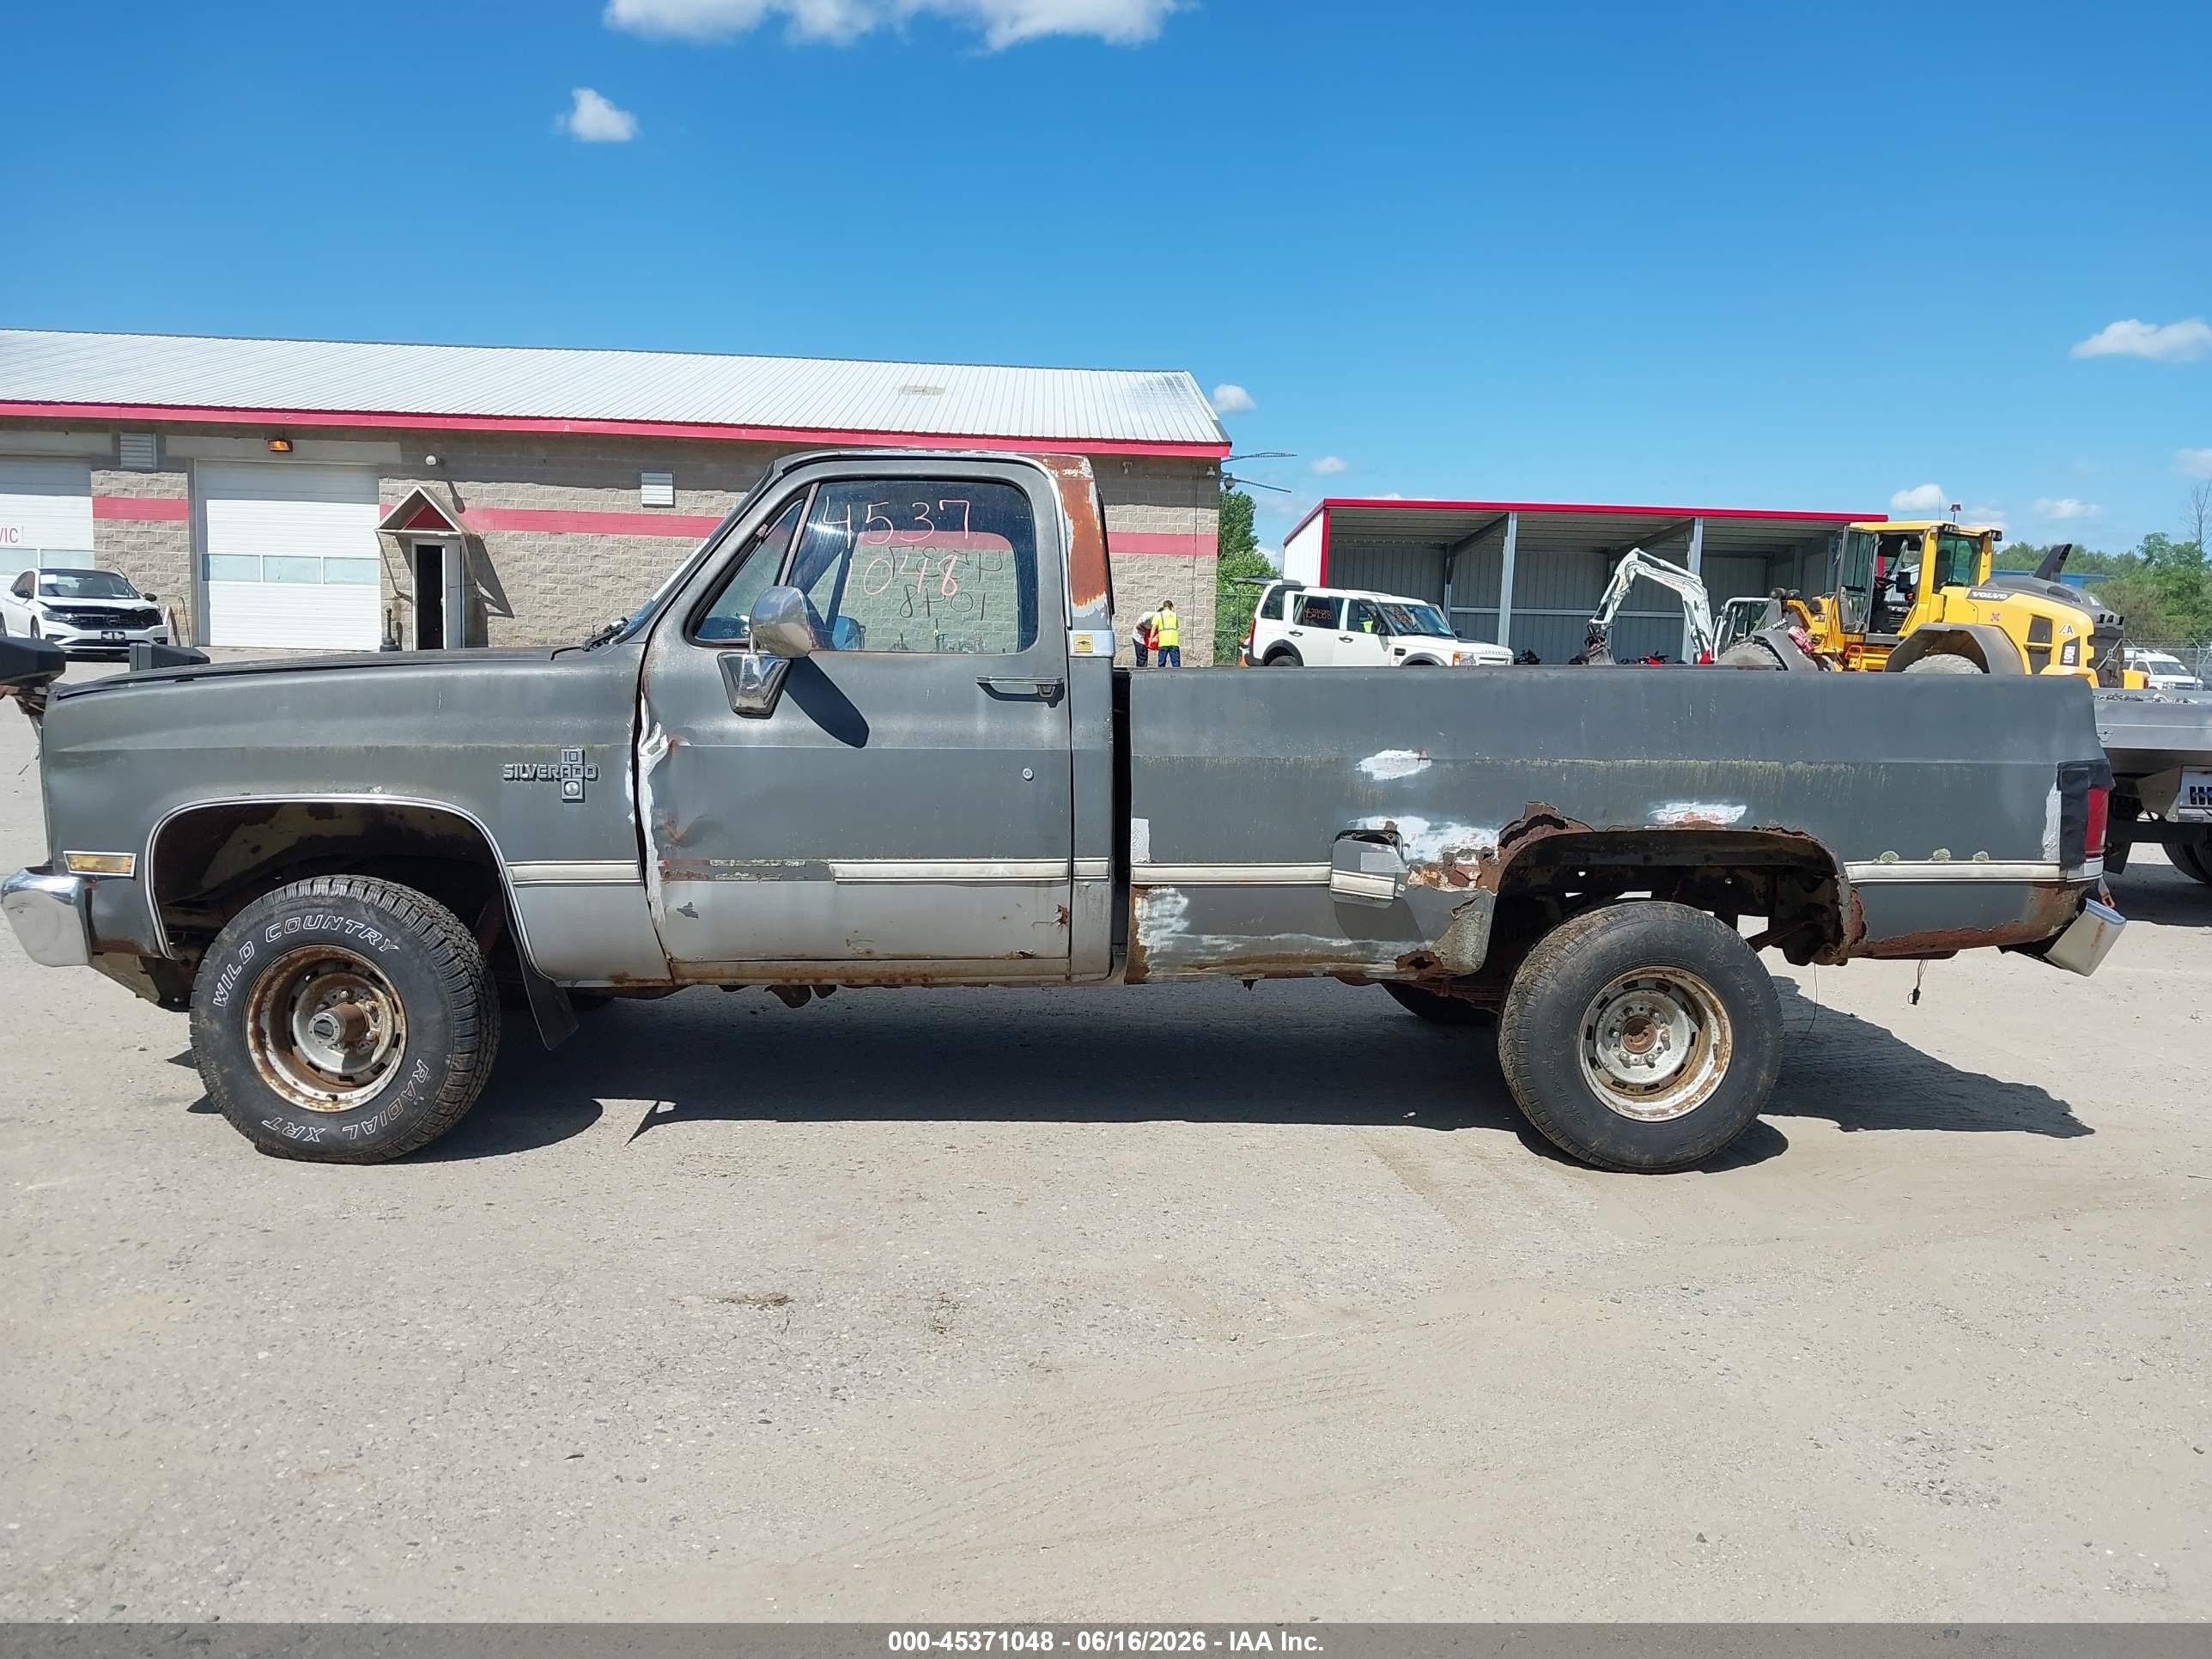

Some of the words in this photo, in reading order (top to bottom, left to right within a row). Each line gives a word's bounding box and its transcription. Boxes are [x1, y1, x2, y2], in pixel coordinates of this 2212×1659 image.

[823, 495, 970, 549] 4537
[845, 554, 958, 596] 1048
[1972, 591, 2008, 599] VOLVO
[502, 763, 599, 782] SILVERADO
[213, 940, 255, 1008] WILD
[265, 914, 399, 953] COUNTRY
[342, 1058, 429, 1140] RADIAL
[260, 1116, 326, 1143] XRT
